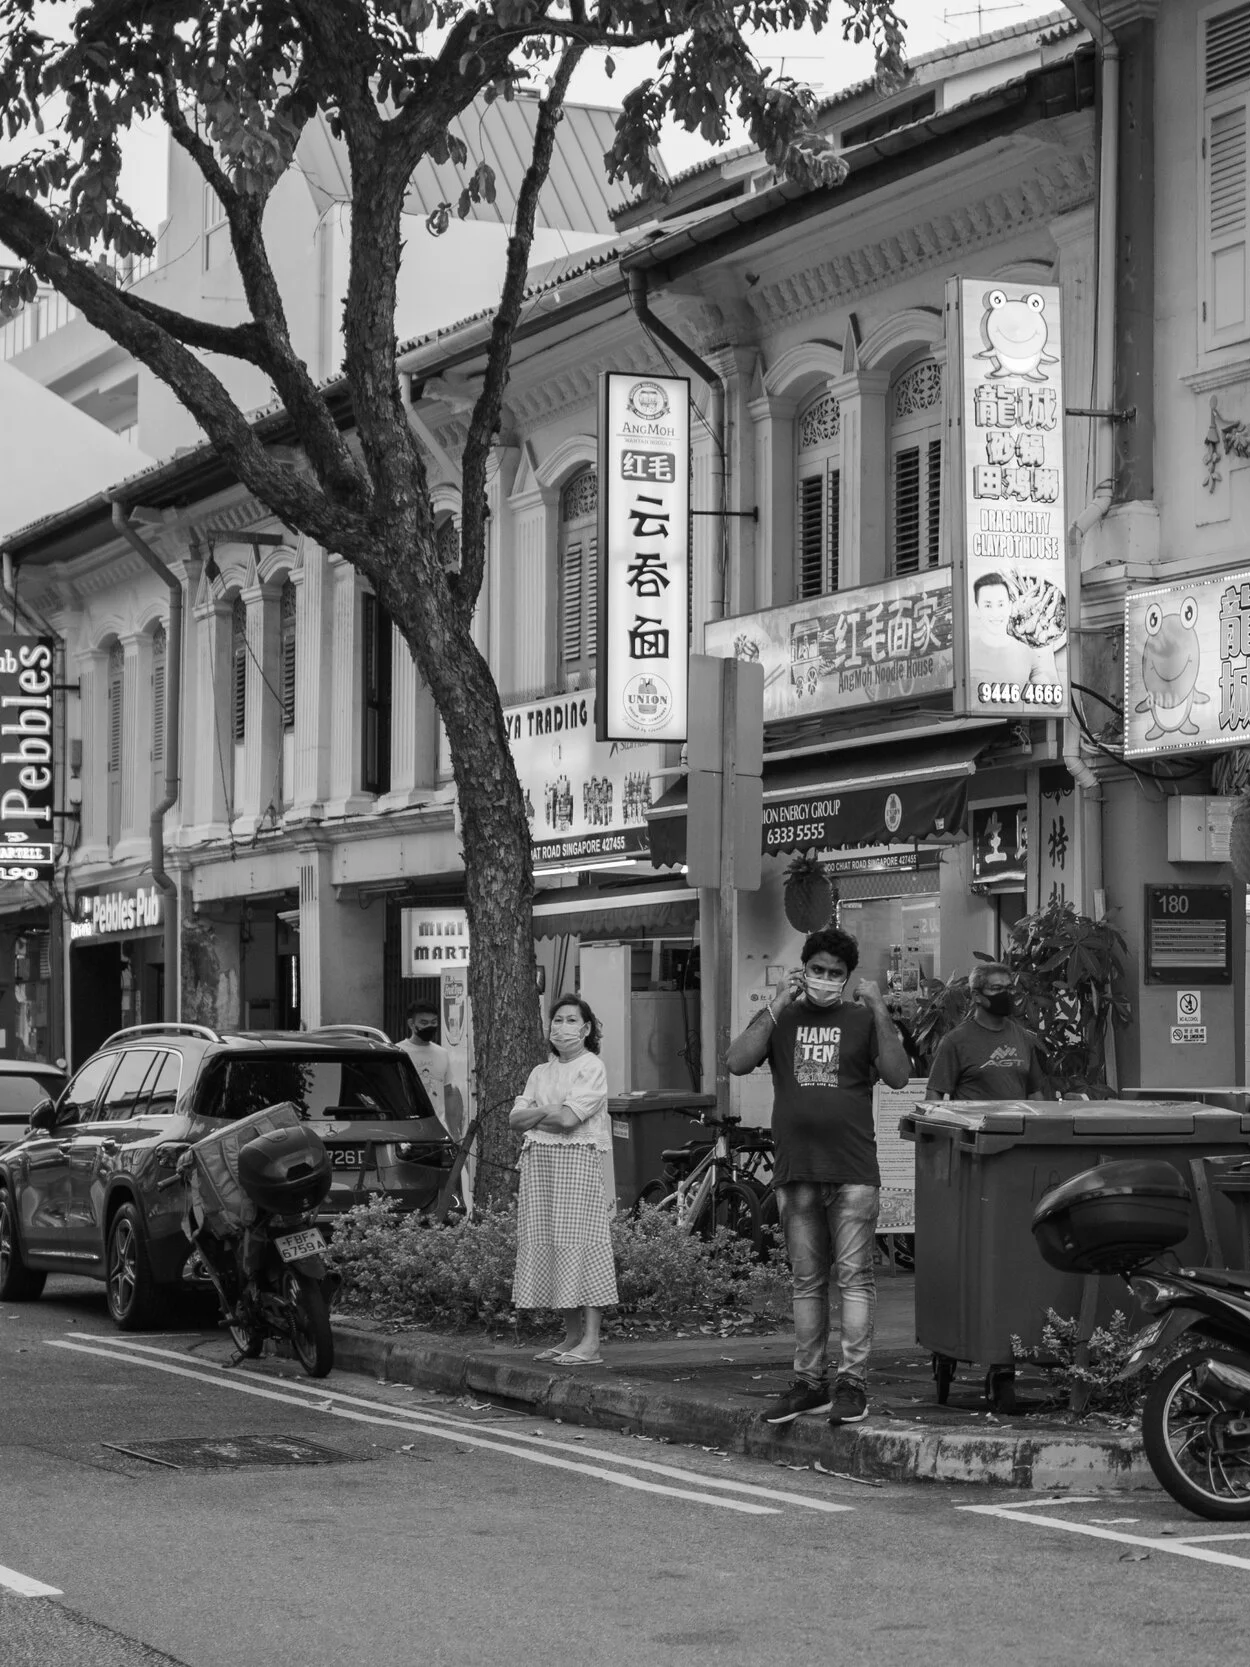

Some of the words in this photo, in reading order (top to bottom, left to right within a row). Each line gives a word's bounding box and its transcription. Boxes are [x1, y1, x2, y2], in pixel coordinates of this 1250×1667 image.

[973, 384, 1058, 431] 龍城
[623, 452, 672, 480] 红毛
[980, 508, 1051, 534] DRAGONCITY
[973, 533, 1021, 558] CLAYPOT
[1022, 536, 1059, 560] HOUSE
[834, 592, 941, 668] 红毛面家
[875, 661, 904, 684] Noodle
[906, 657, 934, 680] House
[628, 694, 668, 705] UNION
[978, 682, 1021, 703] 9446
[1021, 683, 1063, 705] 4666
[528, 699, 588, 737] TRADING
[1, 645, 52, 820] Pebbles
[763, 808, 779, 824] ION
[780, 803, 811, 822] ENERGY
[811, 799, 840, 818] GROUP
[767, 827, 794, 844] 6333
[796, 823, 825, 841] 5555
[543, 845, 561, 859] ROAD
[562, 839, 601, 856] SINGAPORE
[602, 836, 625, 851] 427455
[836, 861, 851, 872] CHIAT
[852, 859, 867, 870] ROAD
[93, 891, 136, 933] Pebbles
[136, 886, 160, 927] Pub
[1158, 895, 1189, 913] 180
[418, 921, 463, 936] MINI
[414, 945, 469, 961] MART
[796, 1026, 841, 1044] HANG
[802, 1044, 835, 1063] TEN
[979, 1059, 1025, 1069] AGT
[286, 1232, 309, 1246] FBF
